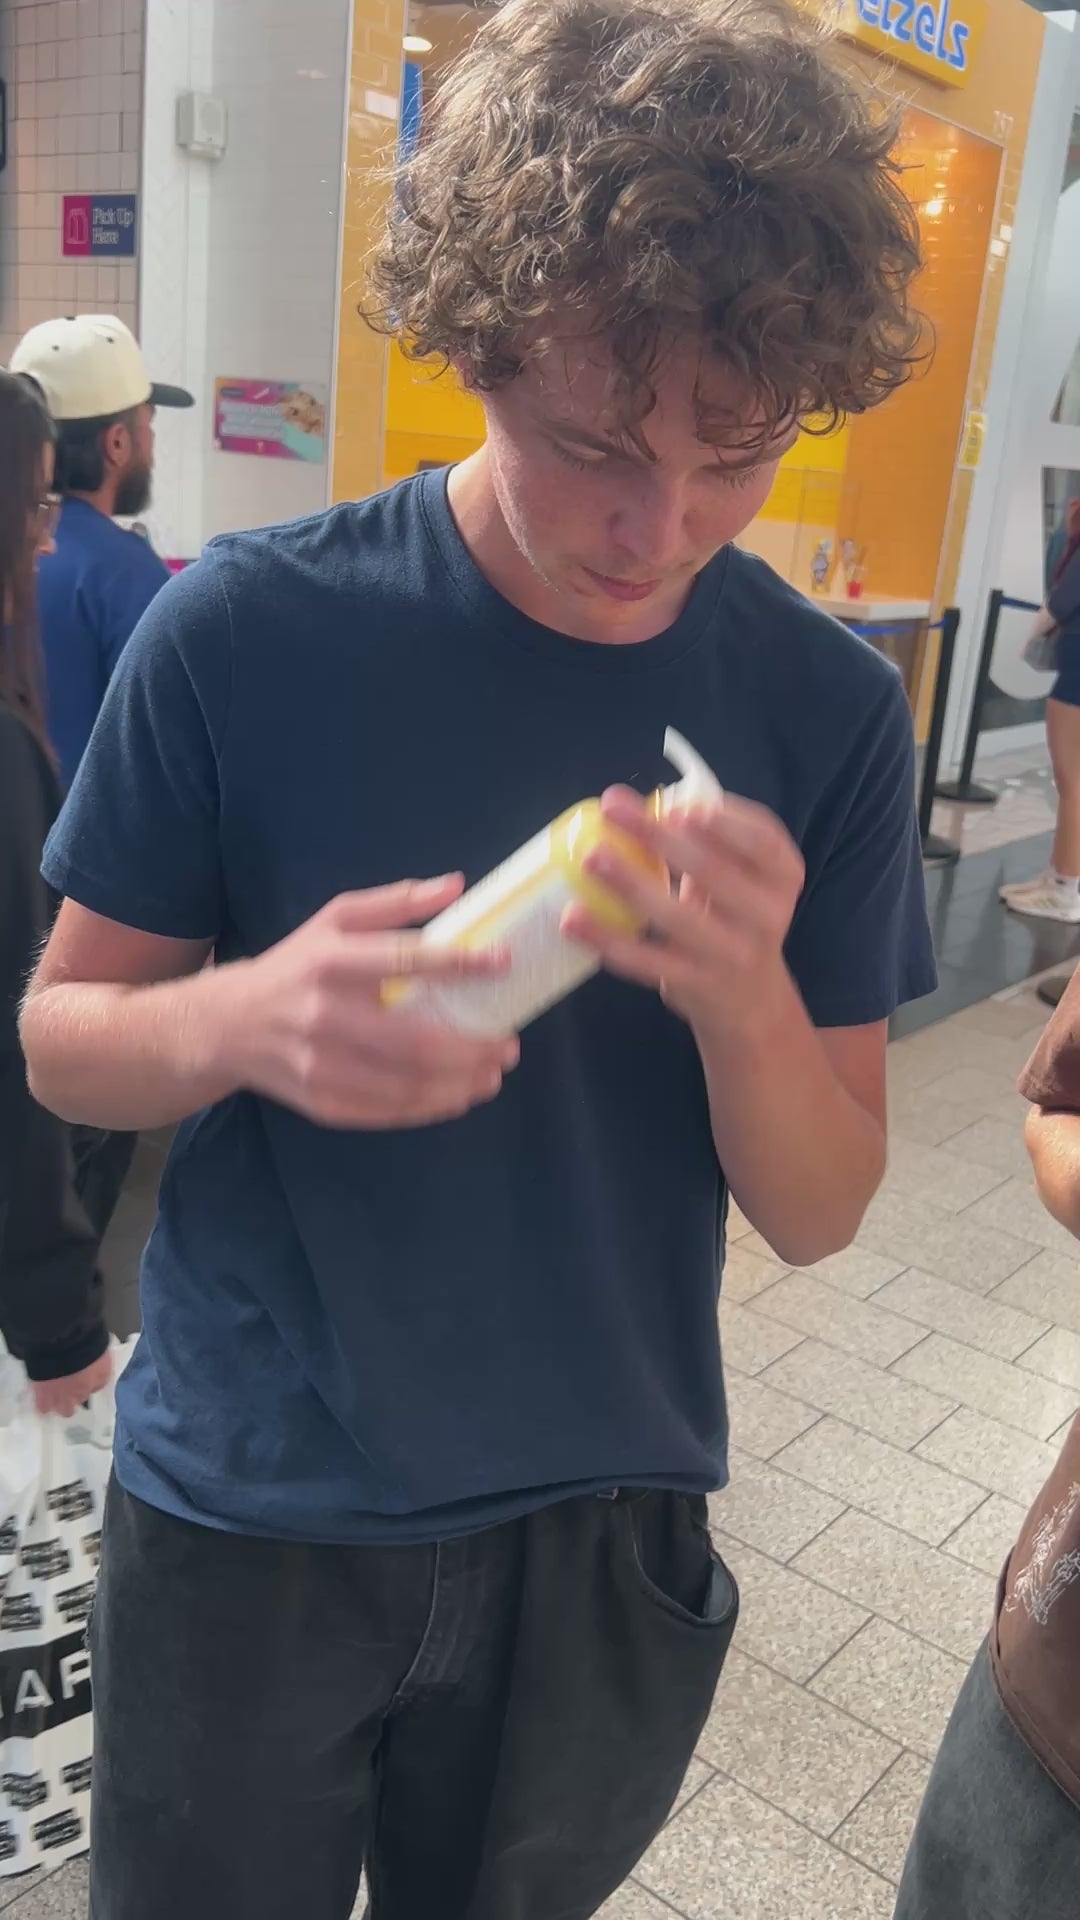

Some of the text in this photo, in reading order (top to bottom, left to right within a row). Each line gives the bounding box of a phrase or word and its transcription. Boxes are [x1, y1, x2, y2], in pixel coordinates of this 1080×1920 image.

[852, 0, 970, 70] etzels
[92, 208, 134, 228] Pick Up
